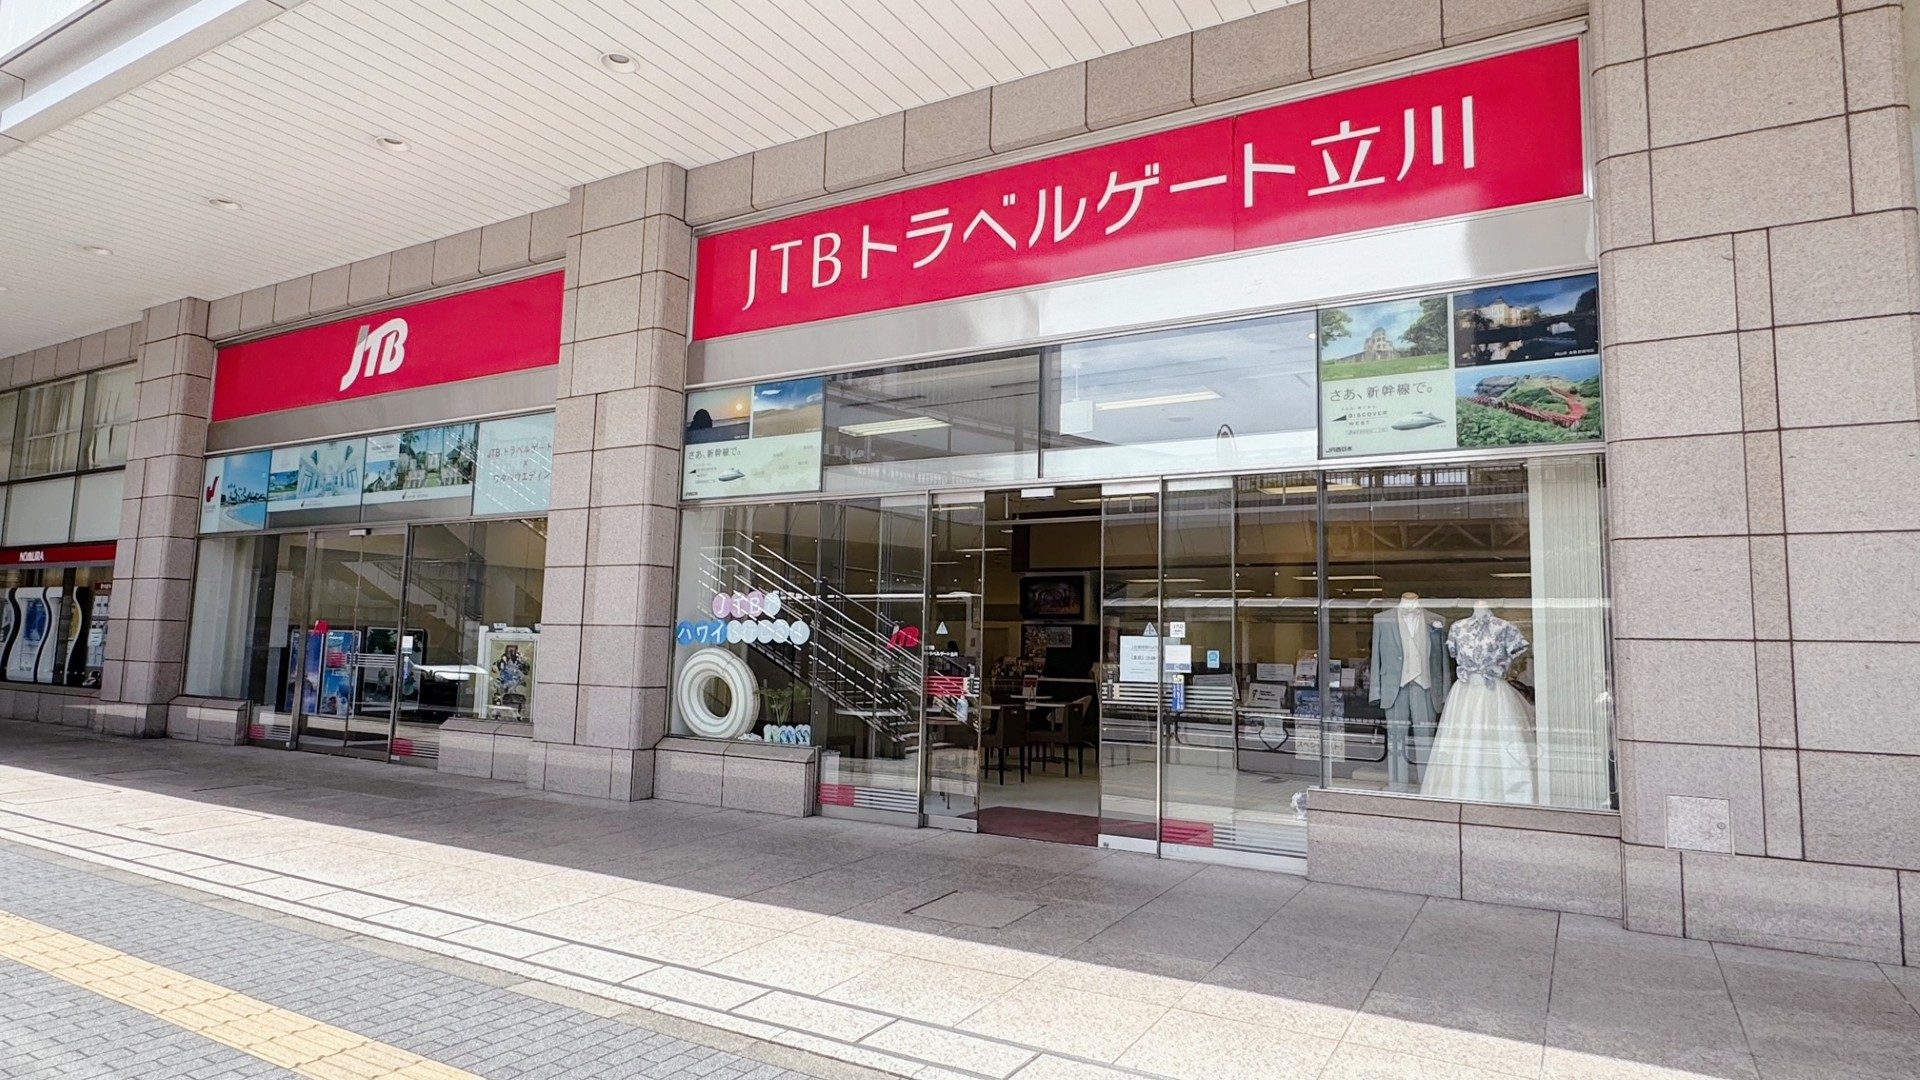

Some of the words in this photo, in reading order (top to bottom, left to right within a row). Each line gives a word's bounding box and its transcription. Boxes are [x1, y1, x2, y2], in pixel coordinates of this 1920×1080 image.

[741, 95, 1475, 311] JTBトラベルゲート立川
[339, 317, 409, 392] JTB
[1329, 382, 1433, 402] さあ、新幹線で。
[18, 550, 45, 562] NOMURA
